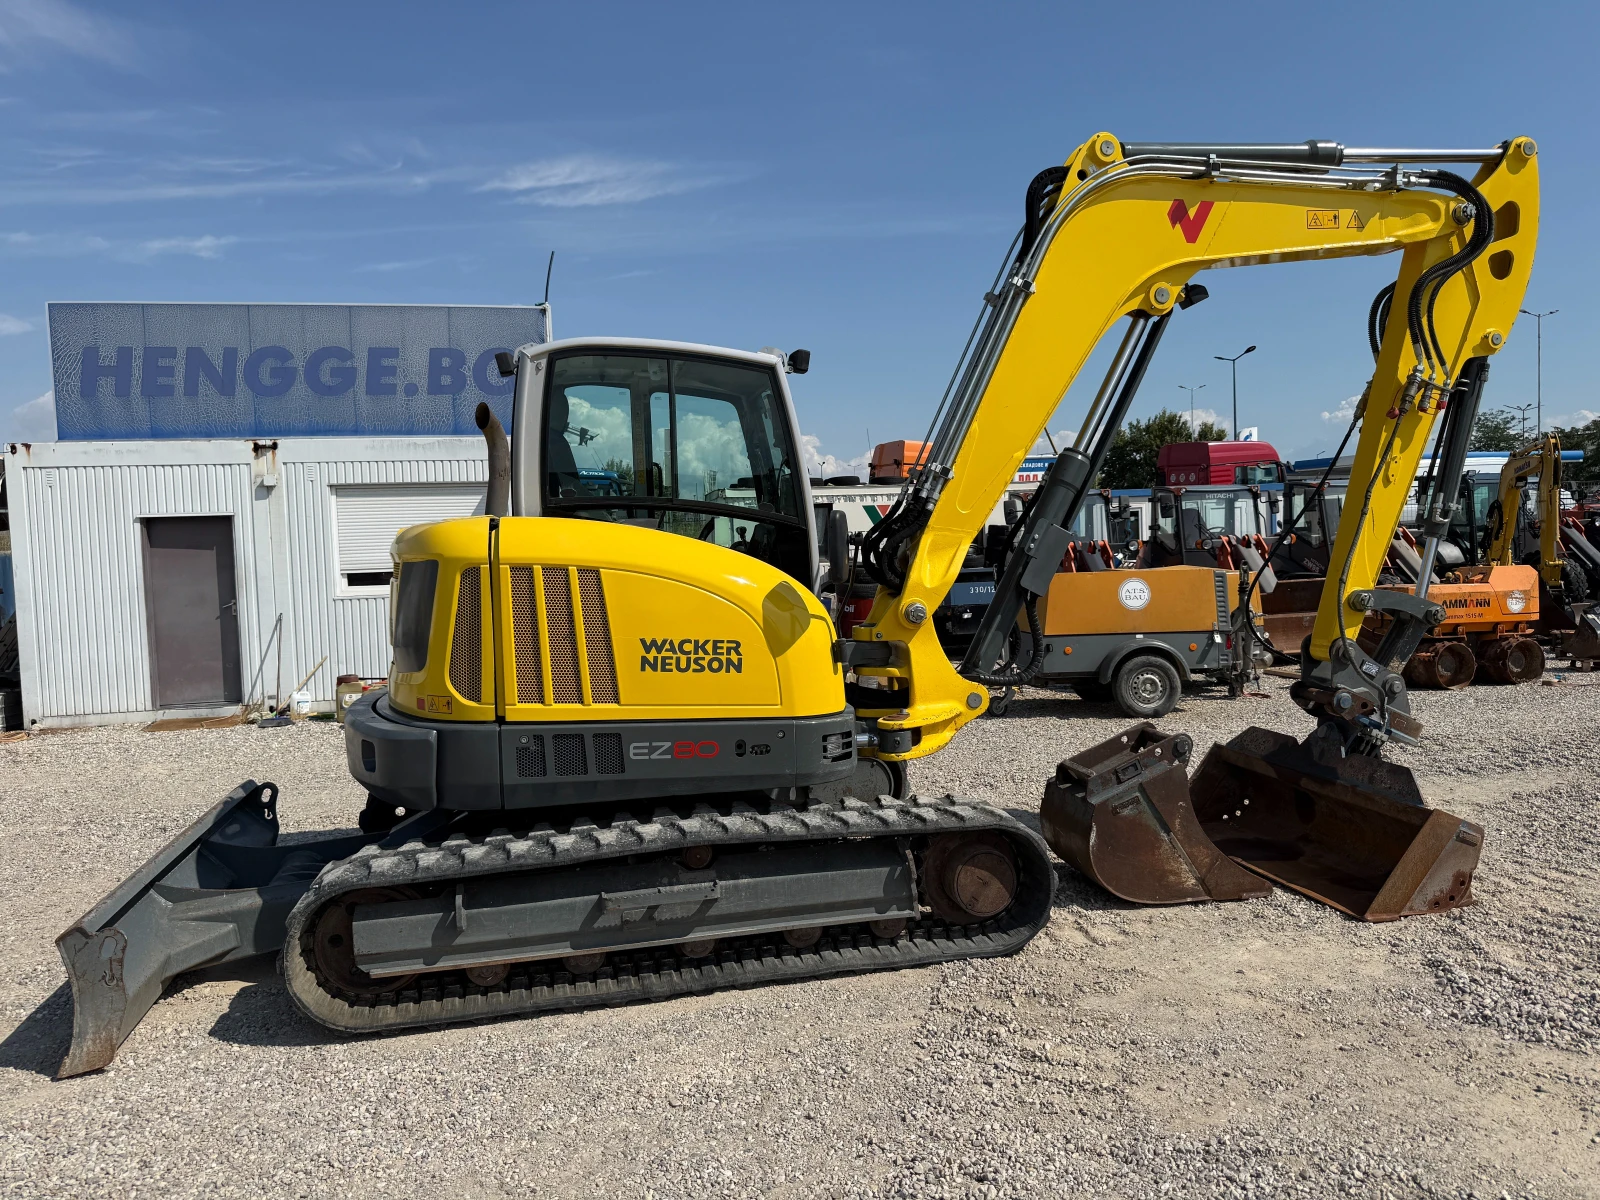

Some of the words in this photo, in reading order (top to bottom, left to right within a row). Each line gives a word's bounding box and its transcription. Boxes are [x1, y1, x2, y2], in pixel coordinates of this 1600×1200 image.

[1442, 598, 1491, 609] AMMANN
[639, 637, 743, 656] WACKER
[640, 655, 743, 674] NEUSON
[629, 740, 720, 760] EZ80
